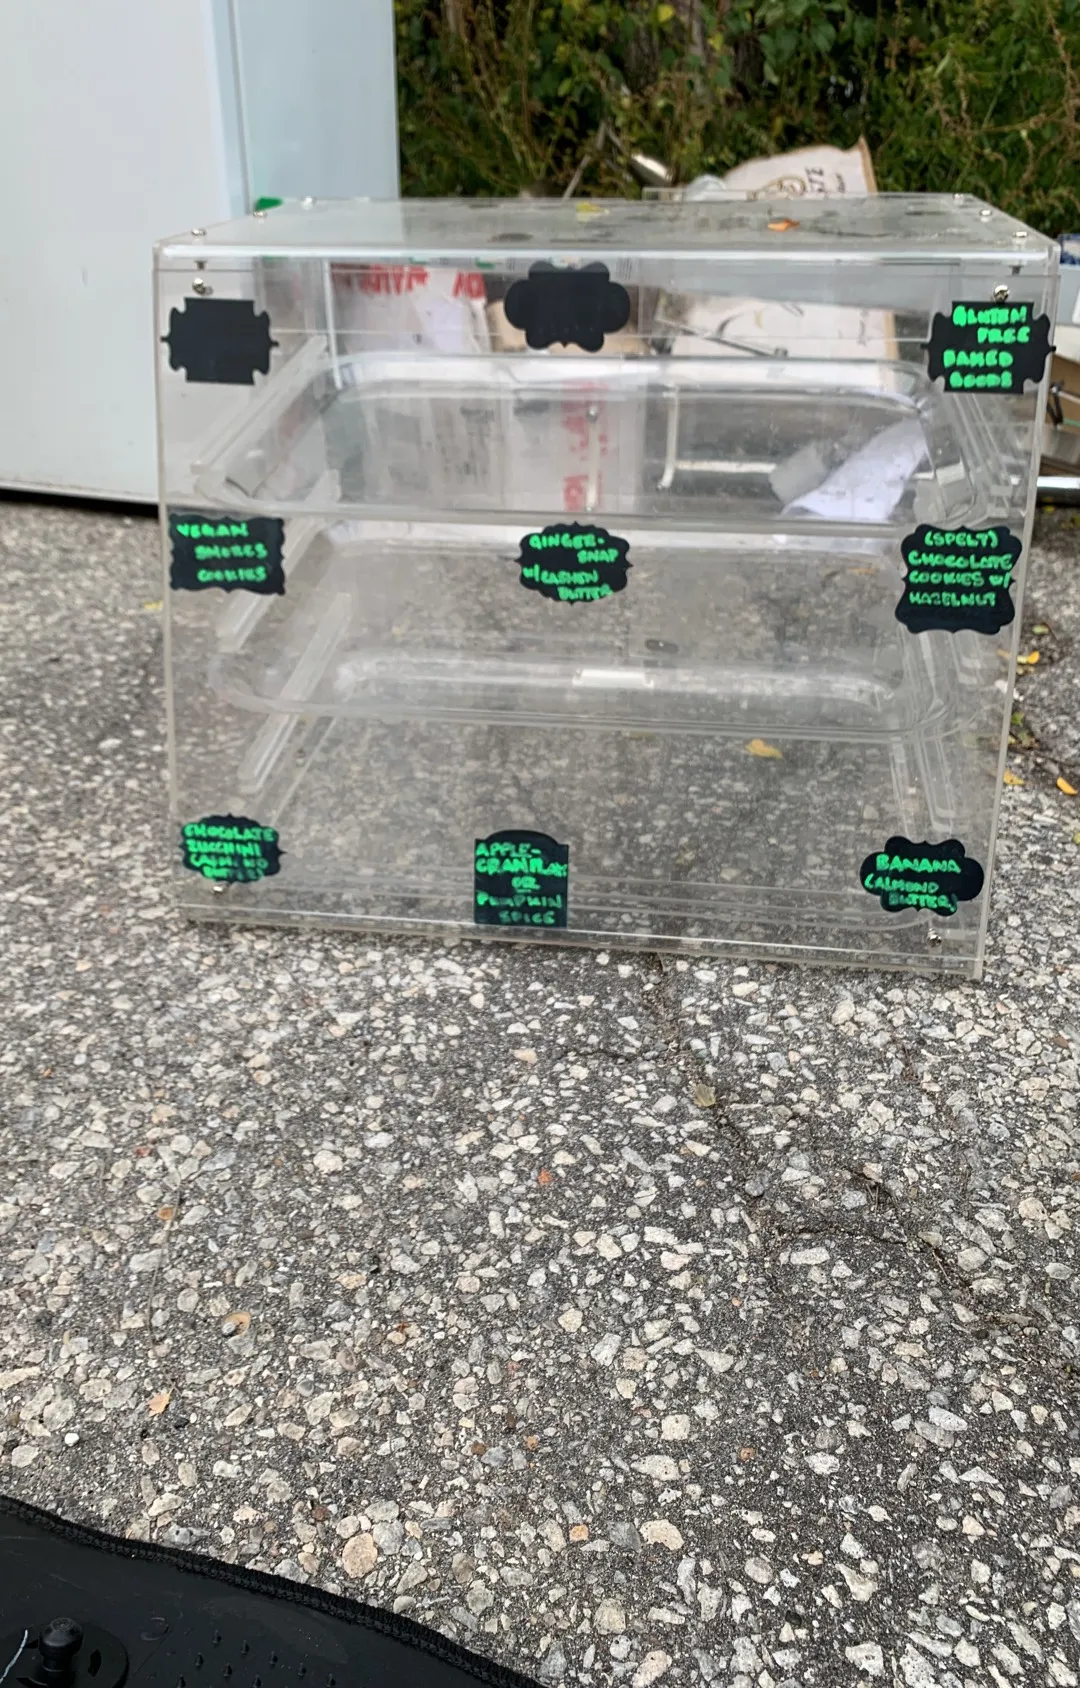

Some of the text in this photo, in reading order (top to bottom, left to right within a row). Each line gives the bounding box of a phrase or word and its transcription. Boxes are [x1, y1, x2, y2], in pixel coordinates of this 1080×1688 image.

[977, 327, 1030, 344] FREE
[943, 349, 1013, 368] BAKED
[949, 371, 1012, 388] GOODS
[176, 522, 249, 538] VEGAN
[924, 530, 998, 548] (SPELT)
[577, 549, 619, 564] SNAP
[908, 550, 1013, 570] CHOCOLATE
[197, 565, 267, 582] COOKIES
[909, 570, 984, 587] COOKIES
[909, 591, 996, 607] HAZELNUT
[184, 823, 276, 842] CHOCOLATE
[186, 839, 262, 857] ZUCCHINI
[876, 854, 961, 873] BANANA
[511, 876, 540, 892] OR
[499, 910, 555, 924] SPICE
